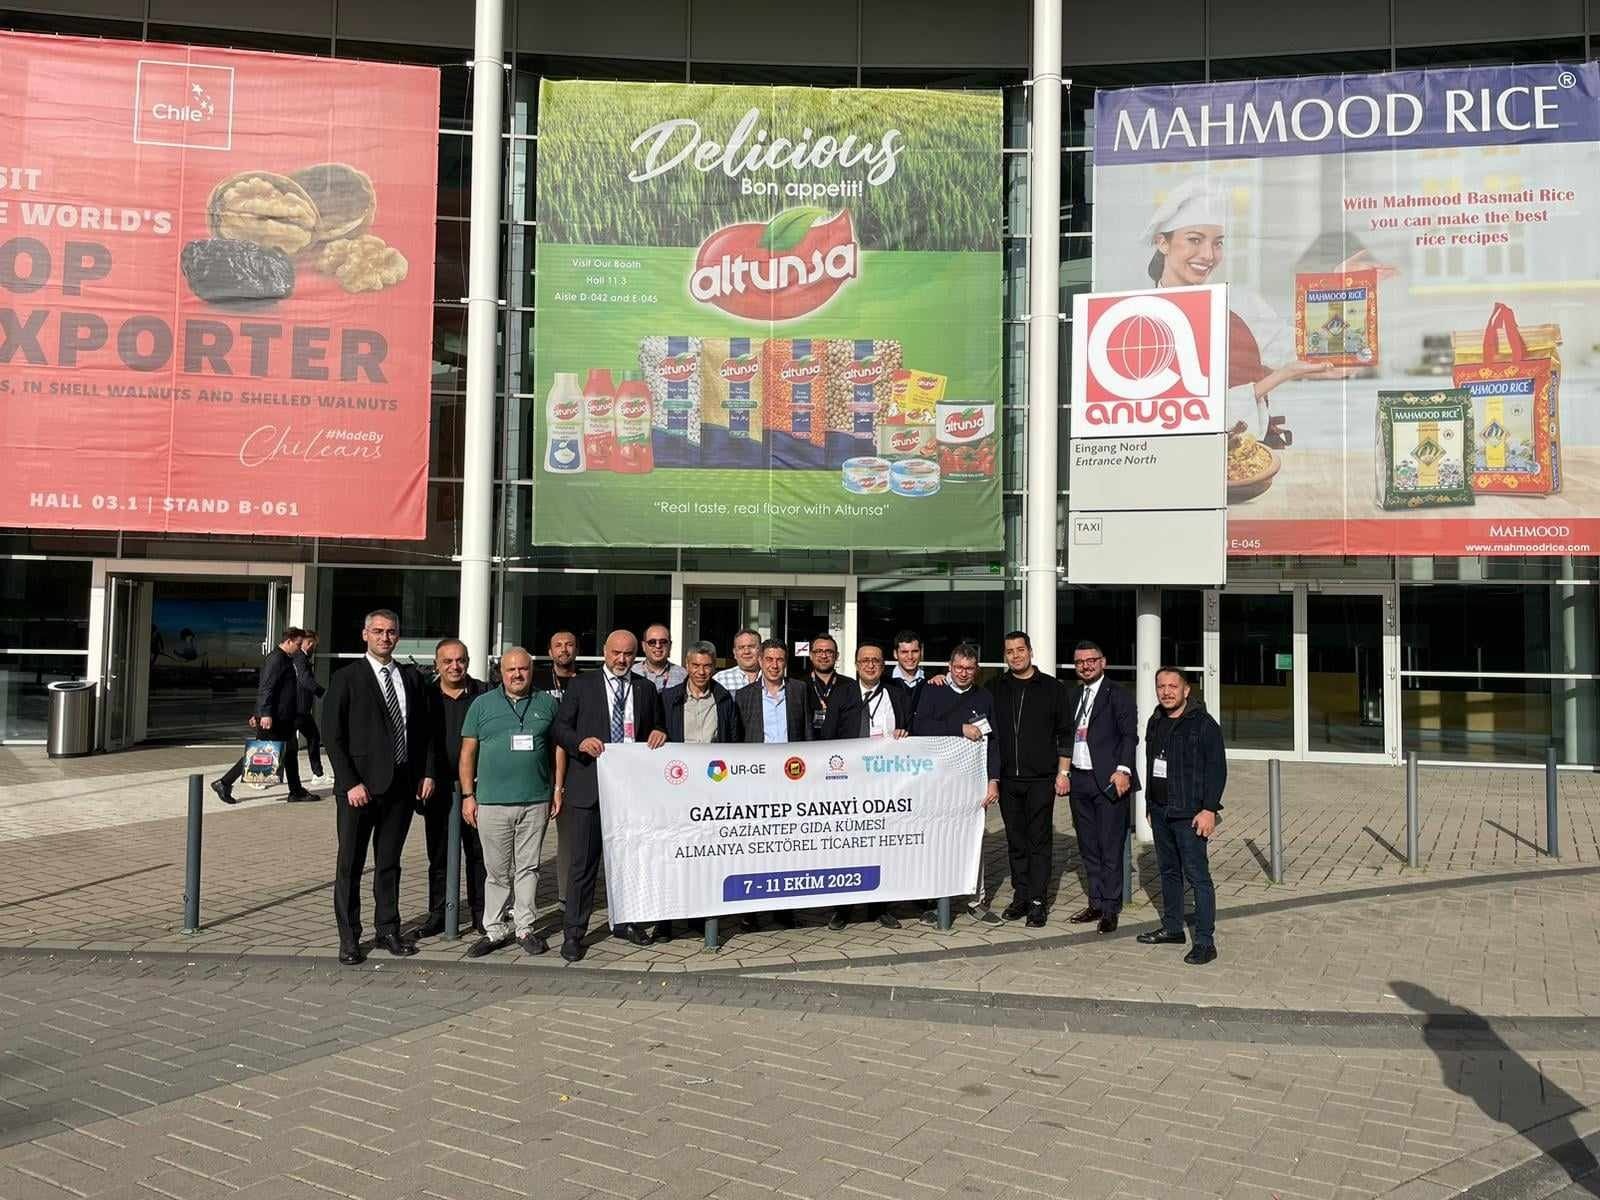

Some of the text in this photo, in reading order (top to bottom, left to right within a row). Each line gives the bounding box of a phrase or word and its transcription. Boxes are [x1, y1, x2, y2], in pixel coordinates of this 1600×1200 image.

[152, 103, 202, 121] Chile
[1113, 94, 1423, 152] MAHMOOD
[628, 107, 905, 186] Delicious
[742, 179, 863, 199] Bon appetit!
[1344, 188, 1575, 210] With Mahmood Basmati Rice
[21, 202, 172, 234] WORLD'S
[1370, 210, 1548, 231] you can make the best
[1416, 232, 1509, 246] rice recipes
[0, 237, 113, 296] OP
[593, 258, 611, 268] Our
[690, 243, 857, 302] altunsa
[610, 294, 629, 303] and
[0, 308, 388, 384] XPORTER
[23, 381, 42, 393] IN
[50, 383, 99, 397] SHELL
[107, 384, 191, 400] WALNUTS
[197, 389, 233, 403] AND
[241, 391, 311, 407] SHELLED
[319, 396, 398, 412] WALNUTS
[1464, 382, 1508, 395] AHMOOD
[1085, 398, 1210, 430] anuga
[1395, 410, 1440, 420] MAHMOOD
[240, 425, 384, 467] Chileans
[325, 430, 384, 443] #MadeBy
[1075, 441, 1147, 455] Eingang Nord
[1075, 454, 1157, 466] Entrance North
[30, 492, 82, 509] HALL
[92, 495, 138, 511] 03.1
[163, 497, 229, 513] STAND
[239, 500, 299, 516] B-061
[694, 502, 730, 515] taste,
[734, 502, 759, 514] real
[763, 502, 801, 514] flavor
[804, 503, 831, 515] with
[1076, 522, 1100, 532] TAXI
[1490, 525, 1570, 537] MAHMOOD
[1231, 539, 1261, 549] E-045
[1465, 543, 1590, 552] www.mahmoodrice.com
[730, 764, 766, 775] UR-GE
[862, 755, 935, 776] Türkiye
[689, 796, 913, 821] GAZİANTEP SANAYİ ODASI
[719, 817, 886, 838] GAZİANTEP GIDA KÜMESİ
[675, 831, 925, 858] ALMANYA SEKTÖREL TİCARET HEYETİ
[743, 880, 753, 894] 7
[766, 878, 780, 893] 11
[784, 873, 824, 891] EKİM
[828, 872, 862, 888] 2023
